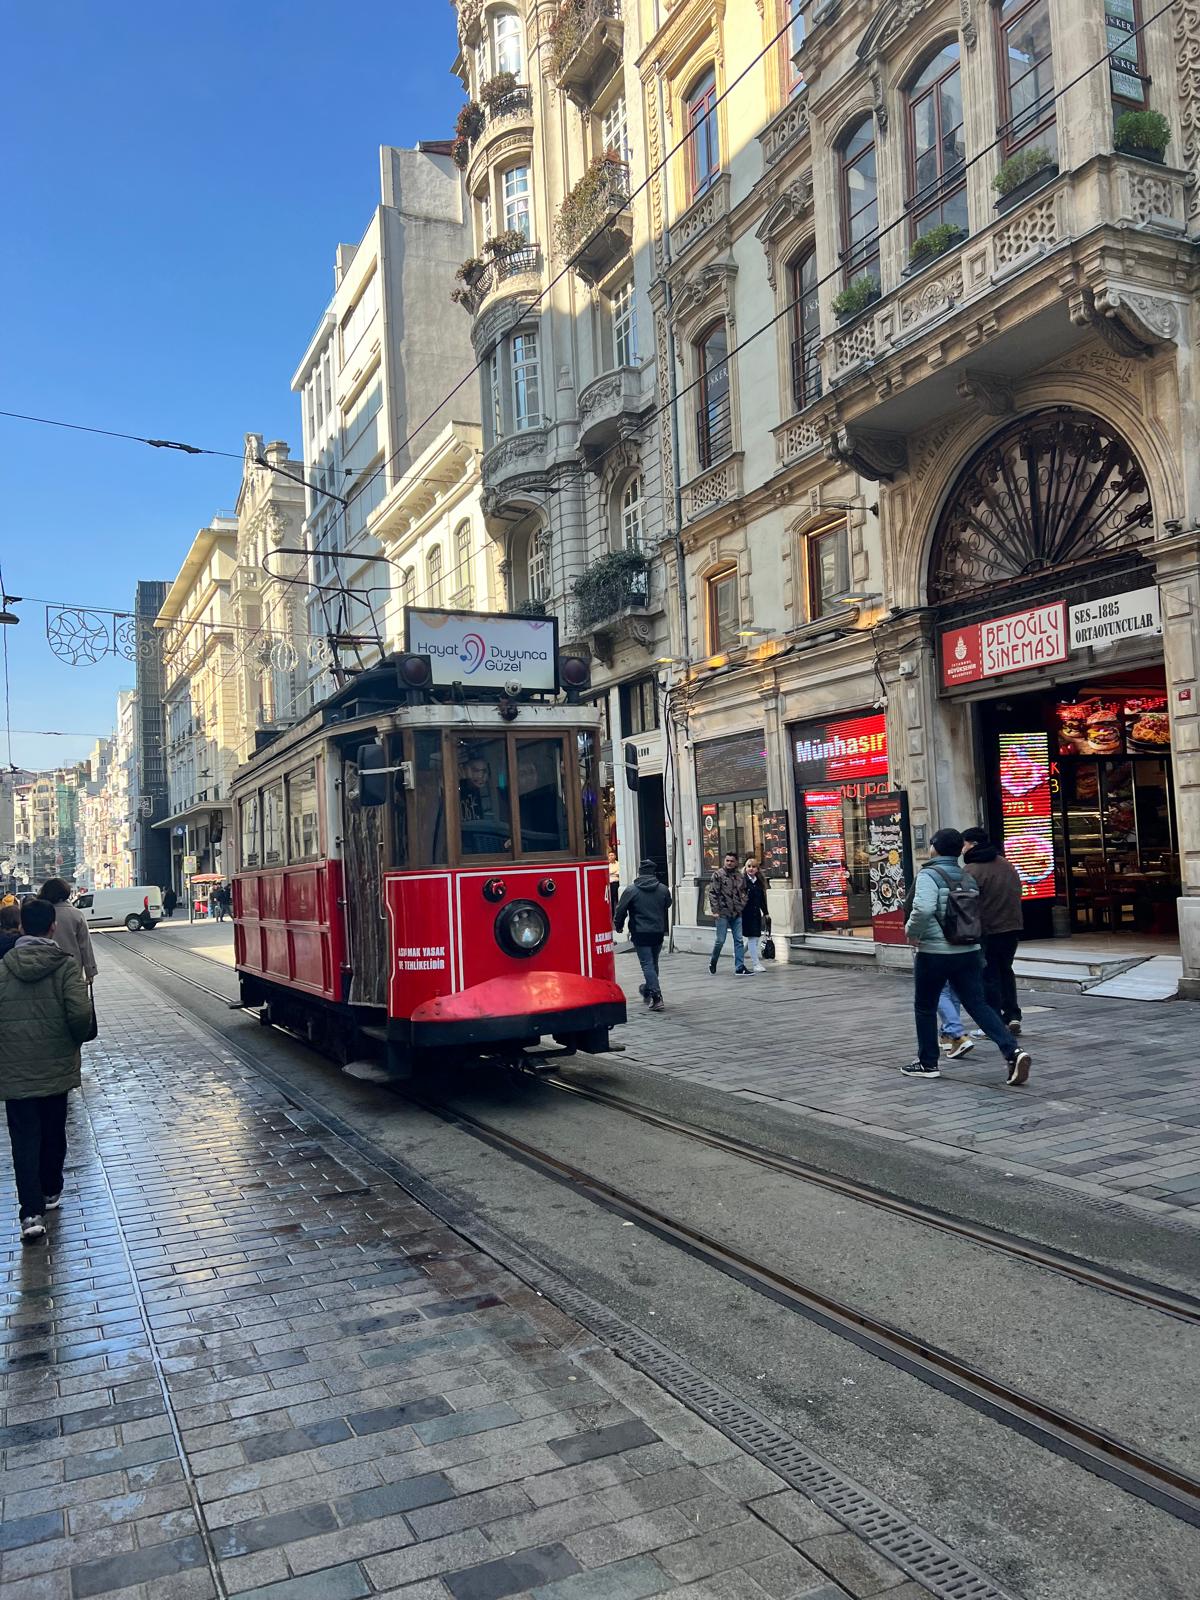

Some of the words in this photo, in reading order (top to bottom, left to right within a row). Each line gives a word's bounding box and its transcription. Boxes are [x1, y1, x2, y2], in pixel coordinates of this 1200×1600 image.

[986, 609, 1058, 648] BEYOĞLU
[1075, 612, 1154, 644] ORTAOYUNCULAR
[417, 641, 459, 657] Hayat
[490, 645, 547, 661] Duyunca
[484, 659, 522, 672] Güzel
[795, 732, 886, 763] Münhasır
[422, 946, 445, 957] YASAK
